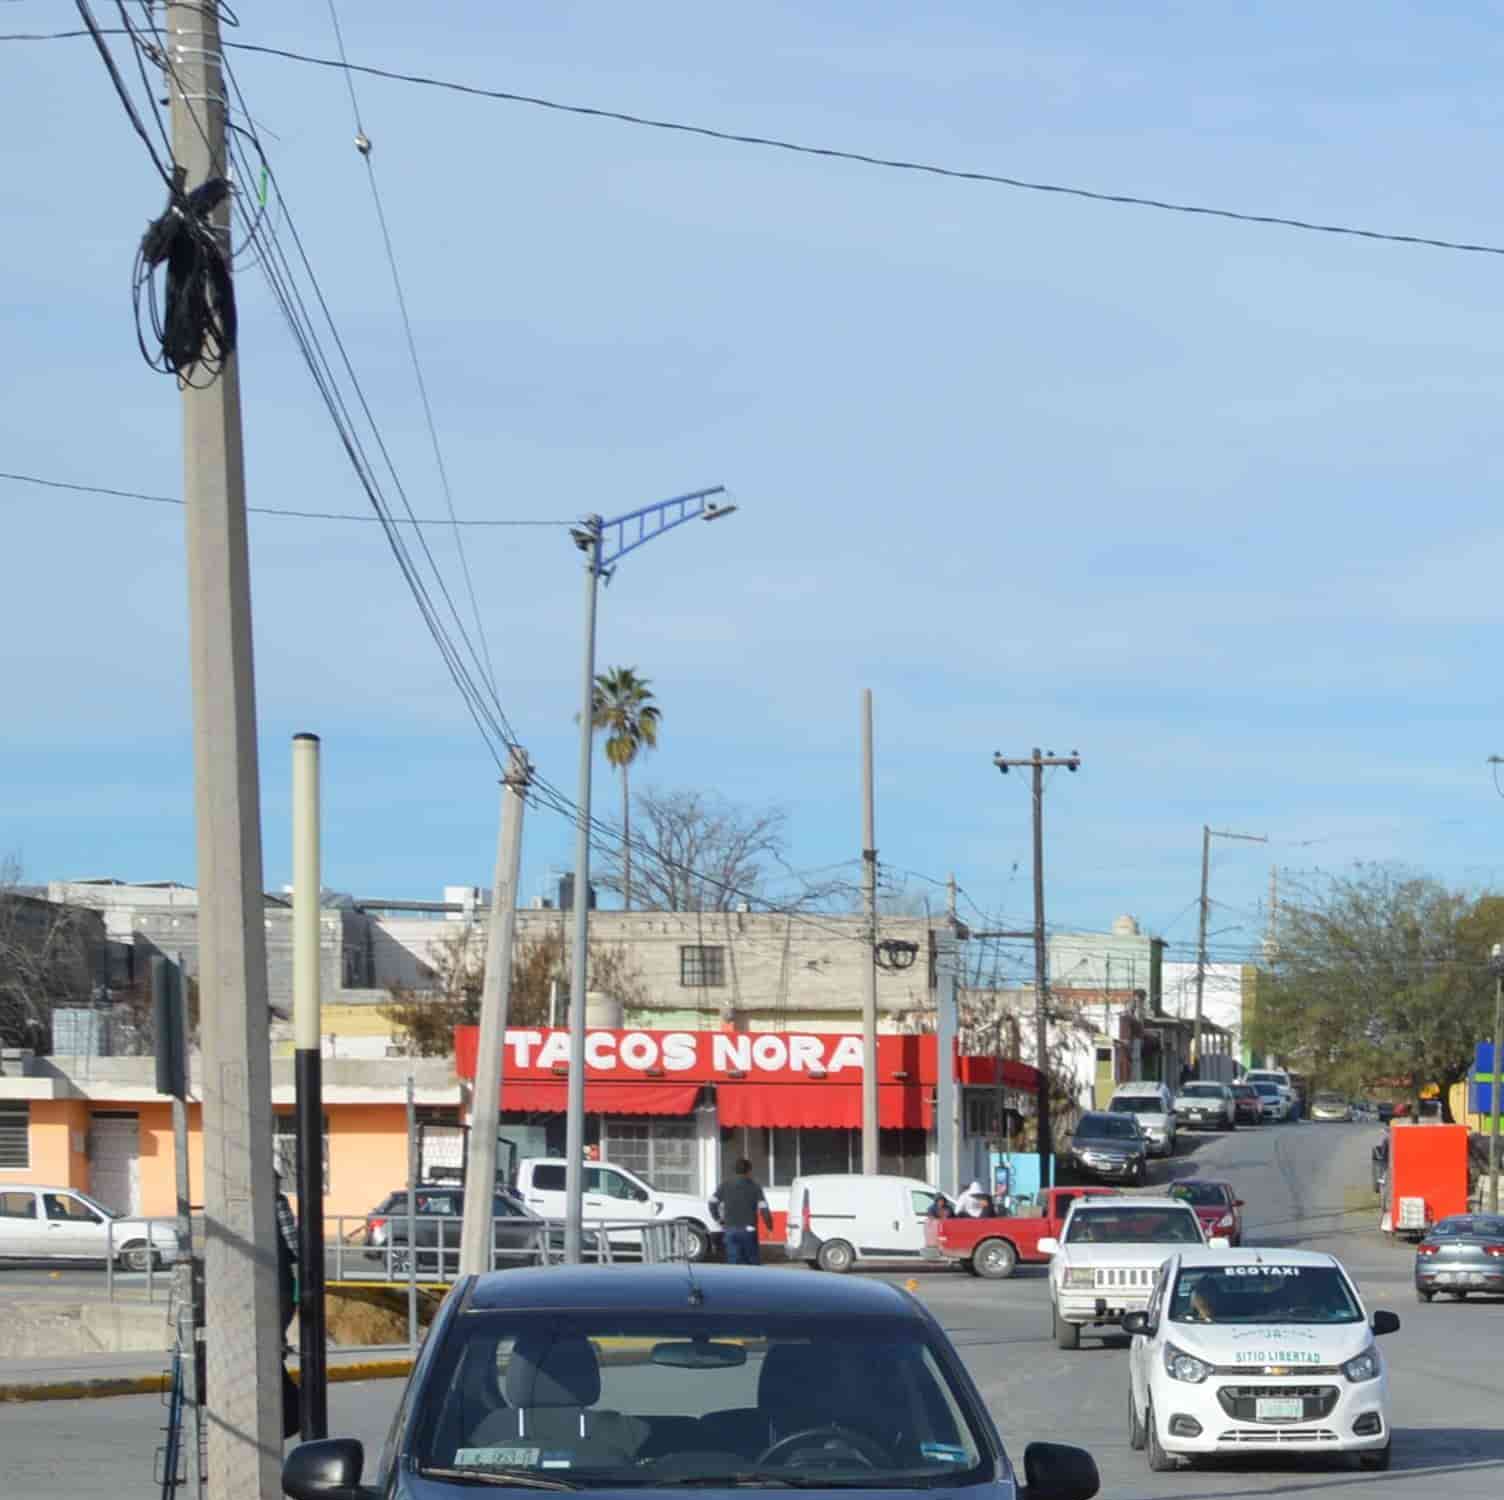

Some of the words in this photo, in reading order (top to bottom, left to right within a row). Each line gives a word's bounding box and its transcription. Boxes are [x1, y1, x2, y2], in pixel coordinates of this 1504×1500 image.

[505, 1031, 697, 1071] TACOS
[712, 1034, 865, 1073] NORA
[1224, 1267, 1300, 1276] ECOTAXI
[1236, 1352, 1265, 1362] SITIO
[1269, 1351, 1320, 1363] LIBERTAD
